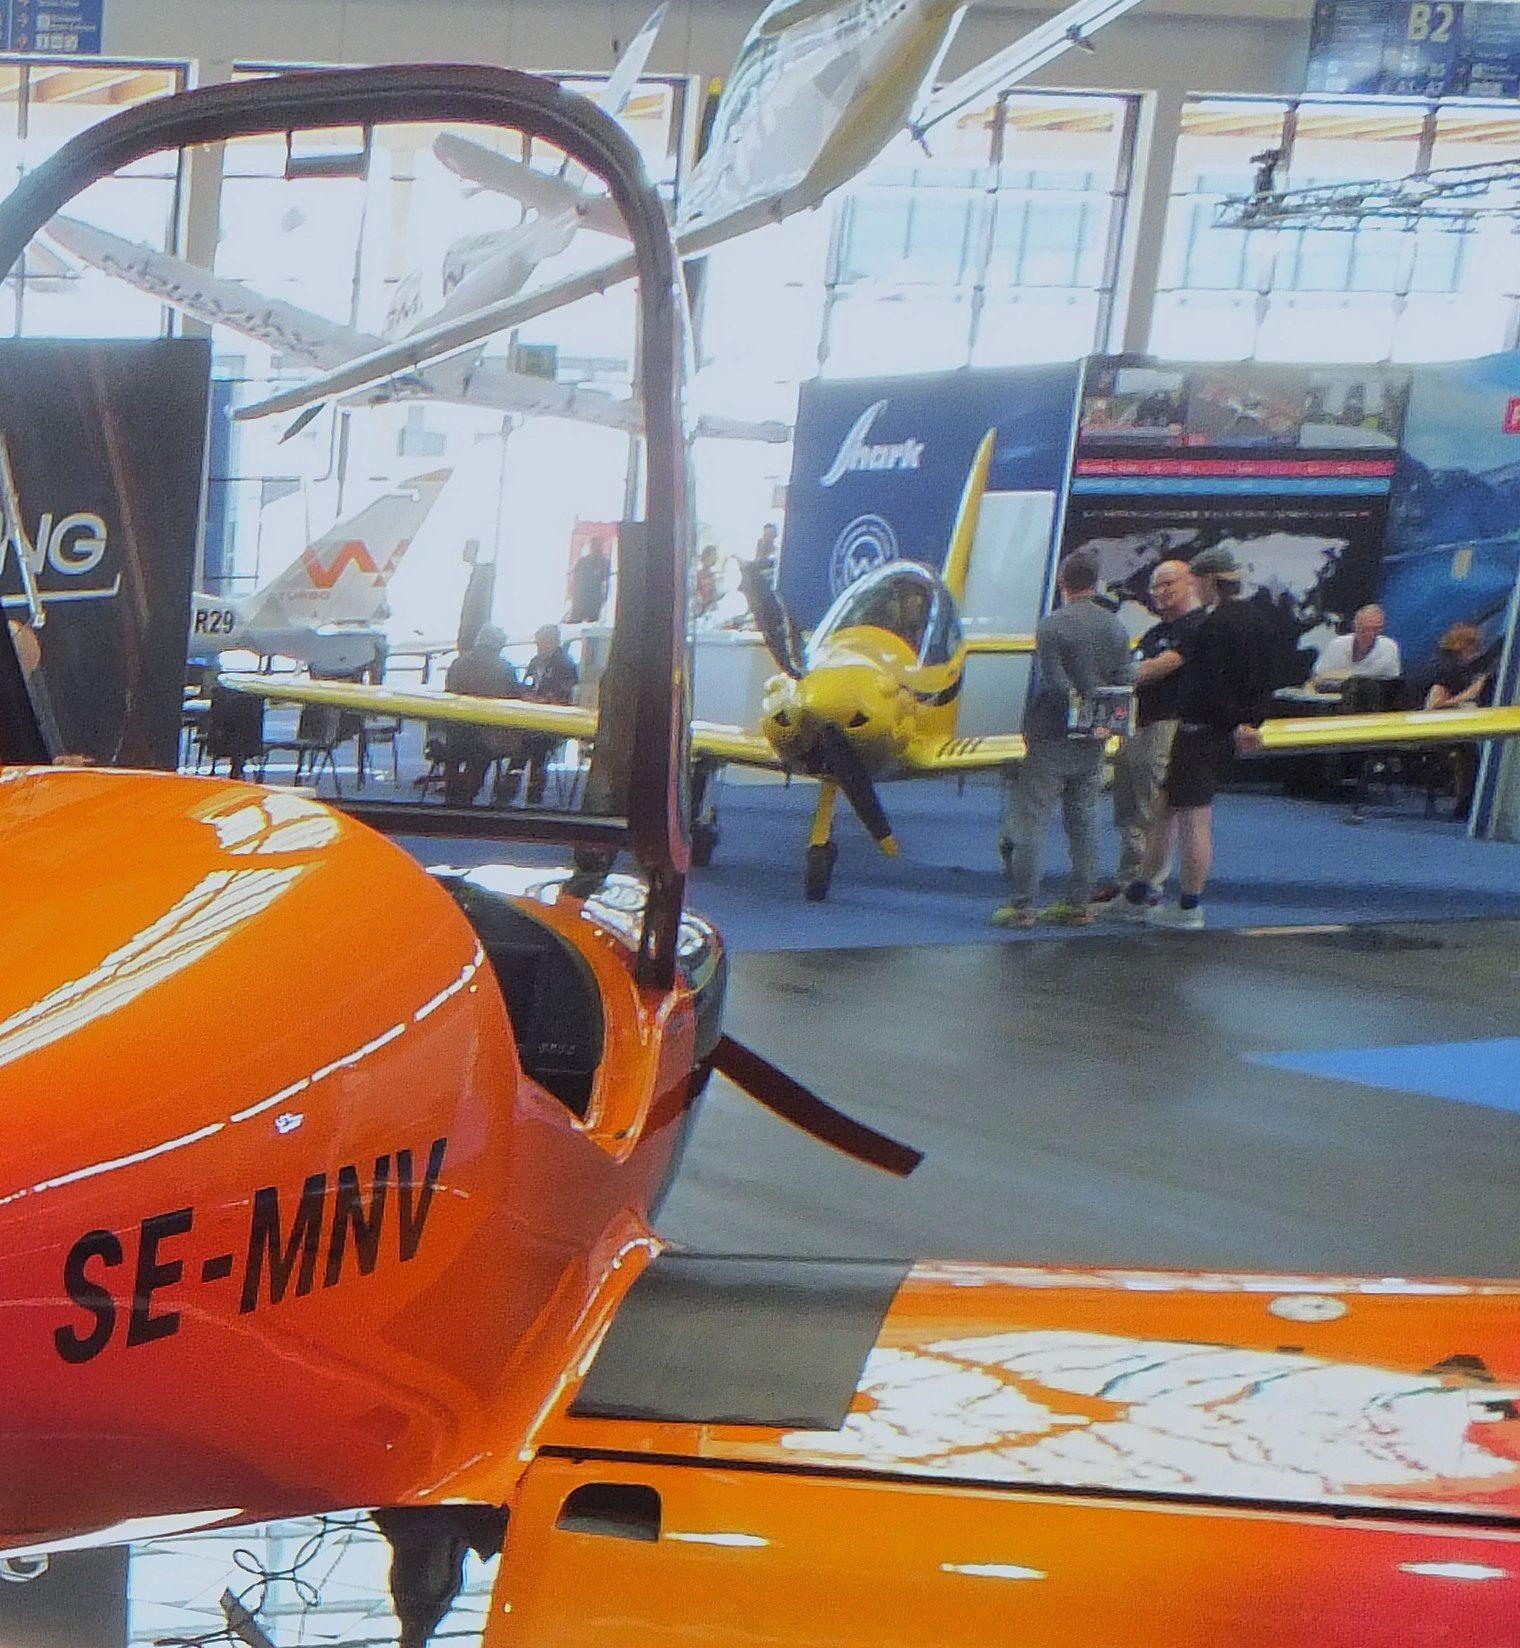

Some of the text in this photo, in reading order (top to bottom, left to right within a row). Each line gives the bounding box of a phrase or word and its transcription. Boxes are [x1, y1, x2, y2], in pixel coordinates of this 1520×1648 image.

[1409, 3, 1454, 43] B2
[194, 610, 235, 634] R29
[54, 1137, 448, 1364] SE-MNV
